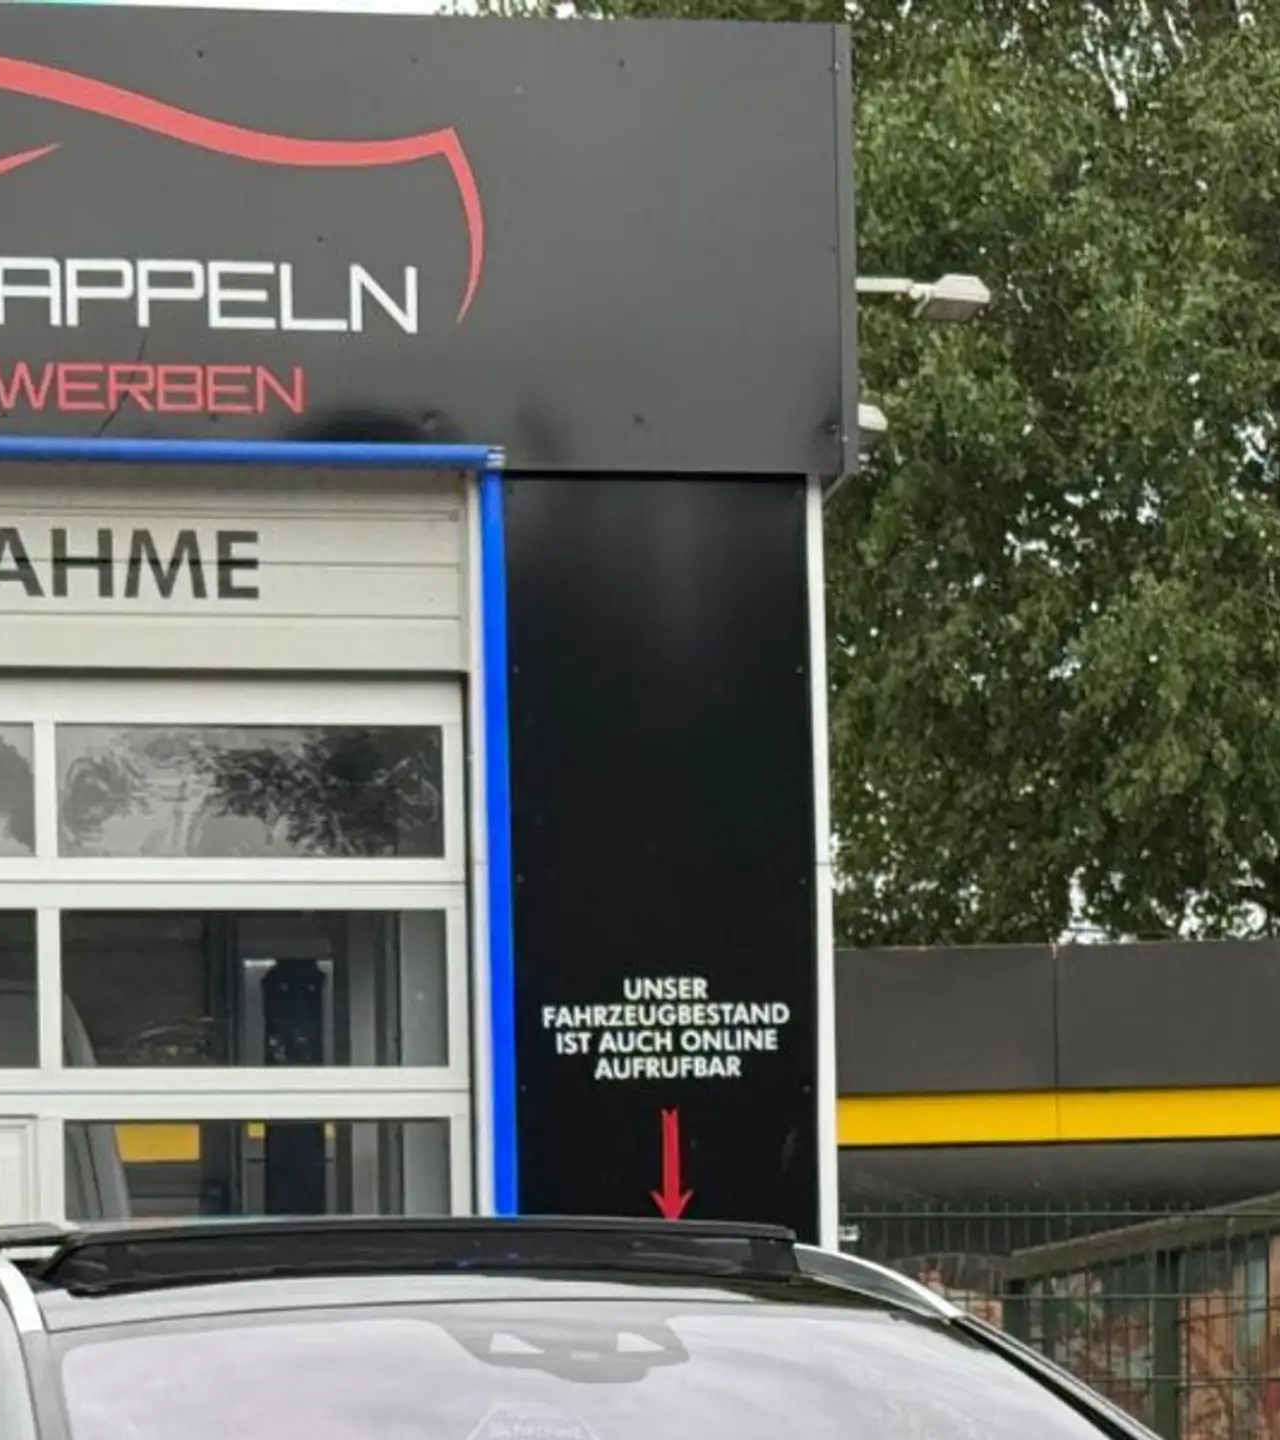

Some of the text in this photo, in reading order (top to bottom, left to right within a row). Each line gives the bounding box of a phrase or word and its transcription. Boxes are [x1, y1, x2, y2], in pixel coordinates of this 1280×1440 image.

[624, 977, 707, 1001] UNSER
[543, 1002, 789, 1028] FAHRZEUGBESTAND
[556, 1028, 777, 1054] IST AUCH ONLINE
[595, 1055, 741, 1079] AUFRUFBAR
